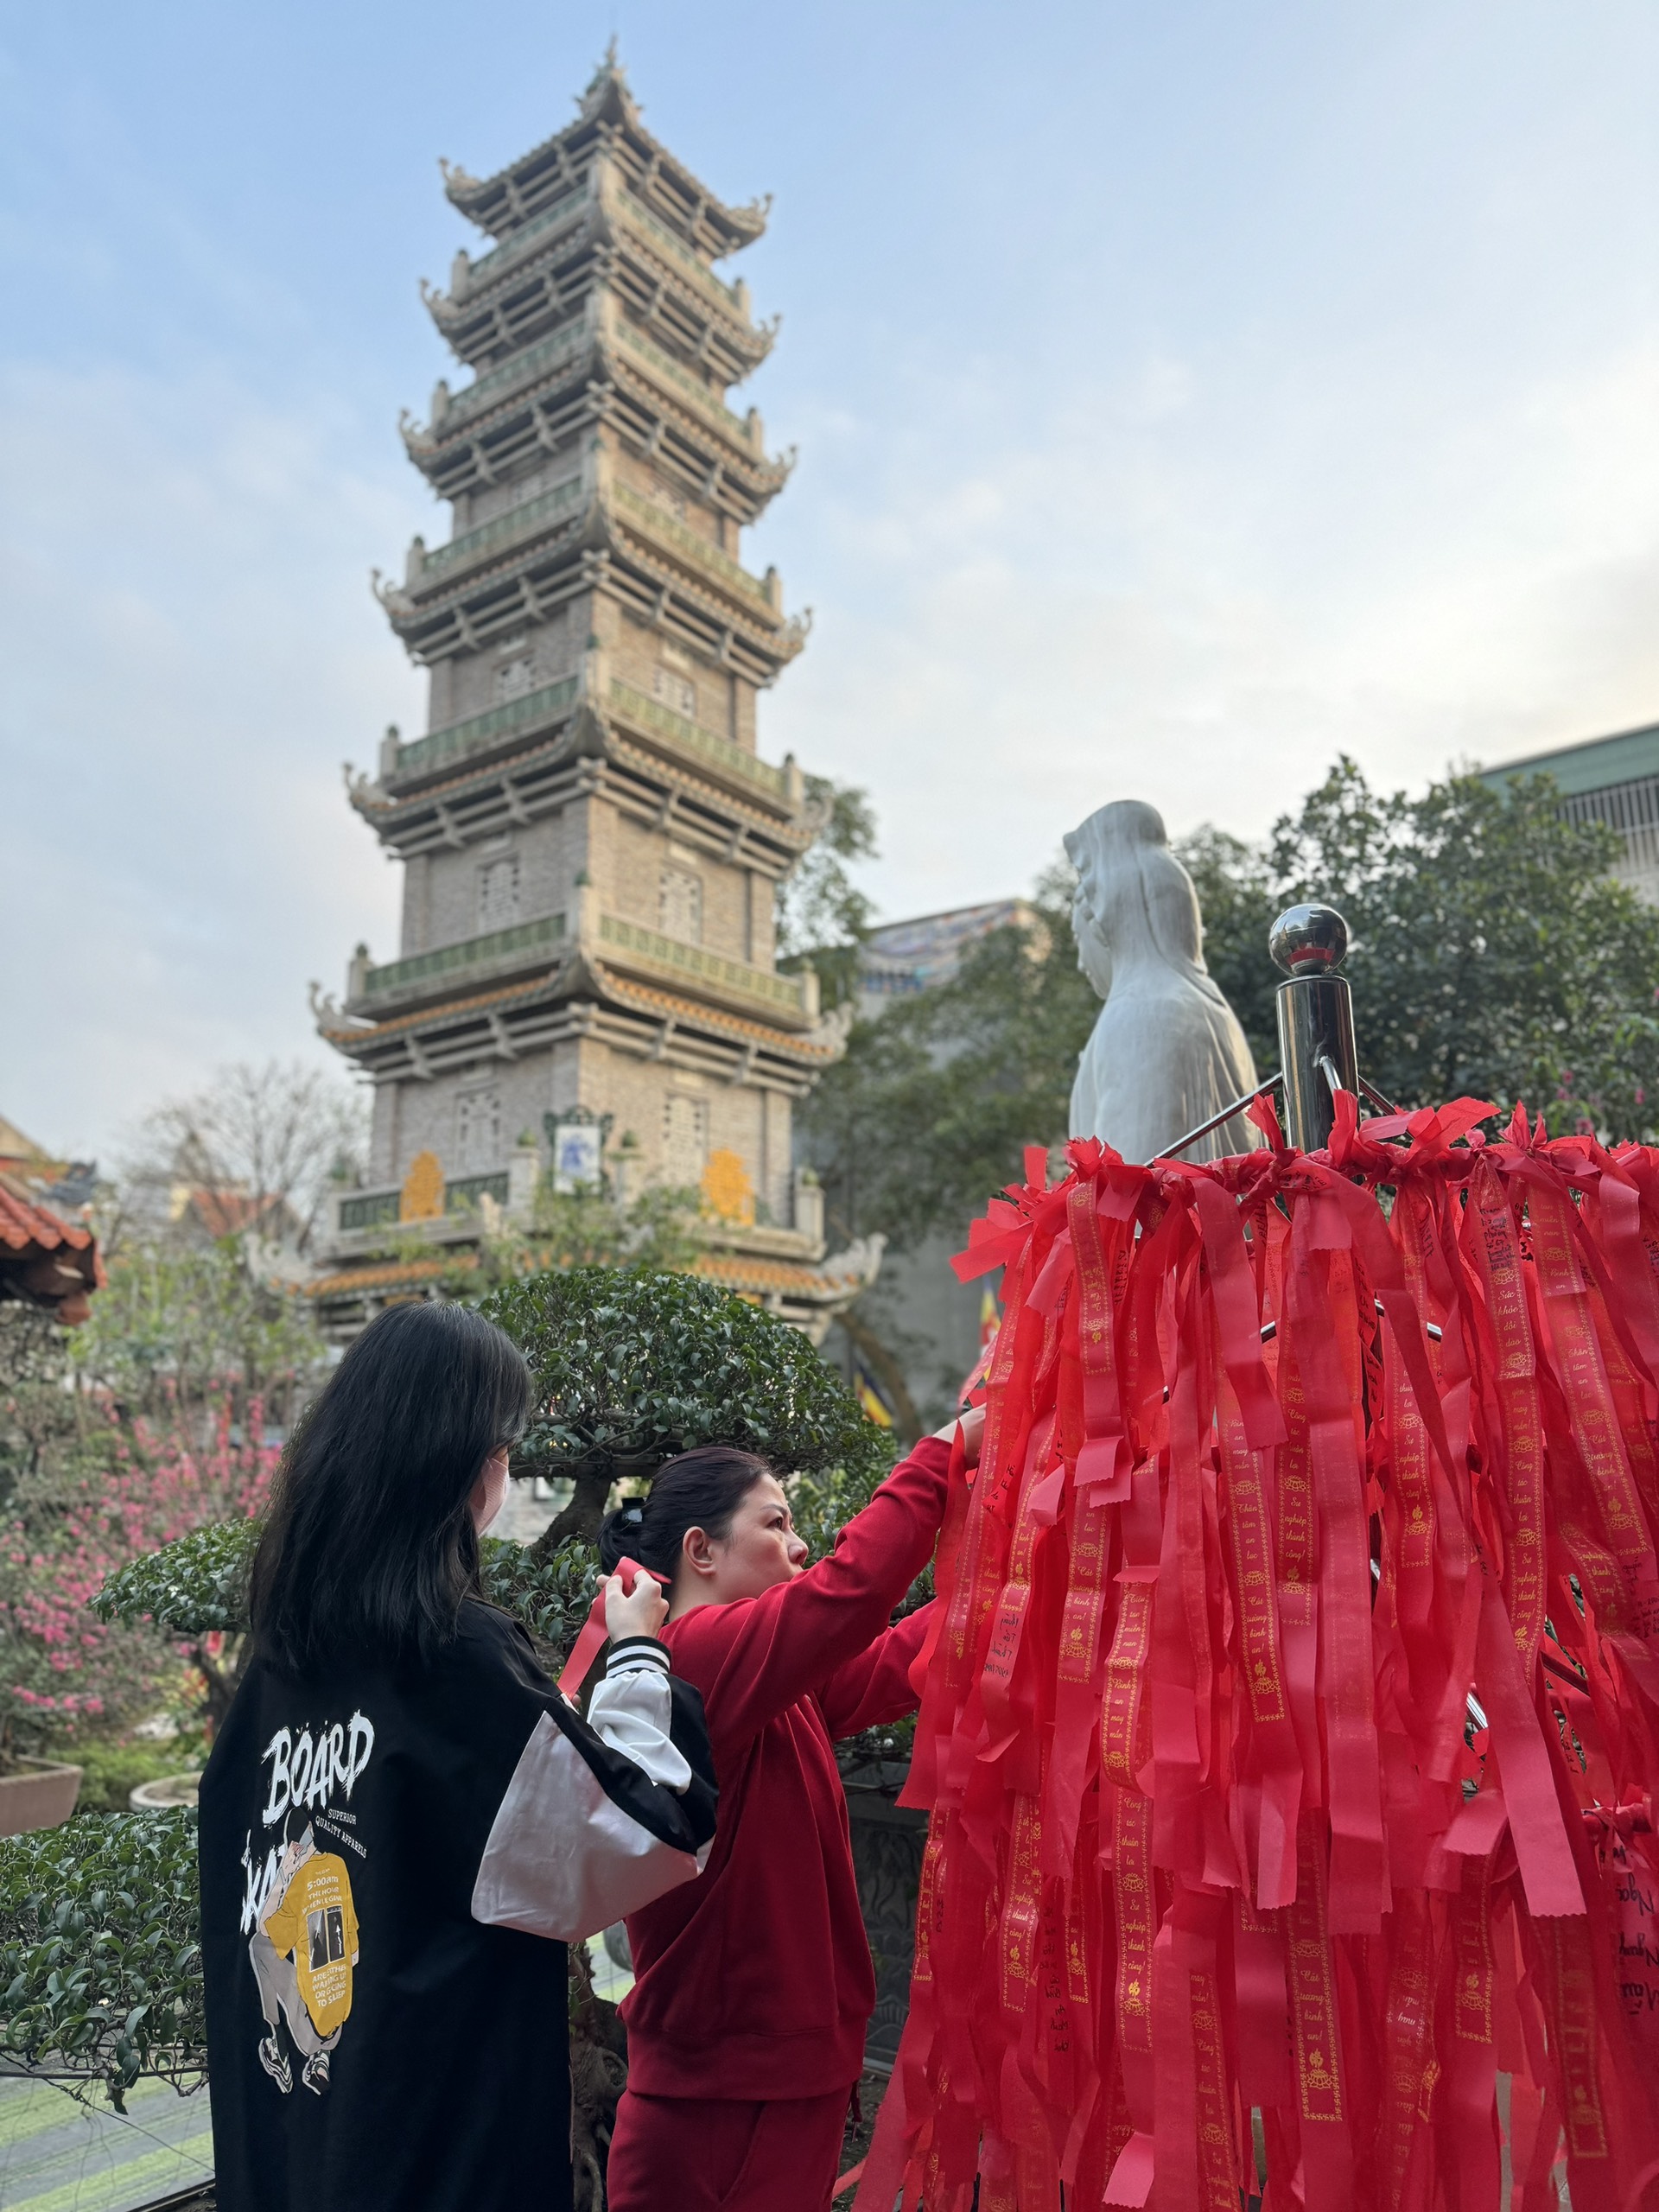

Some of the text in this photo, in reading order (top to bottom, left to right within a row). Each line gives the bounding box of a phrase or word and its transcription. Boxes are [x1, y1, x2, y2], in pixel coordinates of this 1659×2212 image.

[1286, 1549, 1305, 1561] công!
[1516, 1606, 1535, 1620] công!
[260, 1709, 375, 1829] BOARD
[328, 1808, 356, 1825] SUPERIOR
[315, 1815, 367, 1859] QUALITY APPARELS
[312, 1972, 327, 1983] ARE
[315, 1990, 325, 1999] OR
